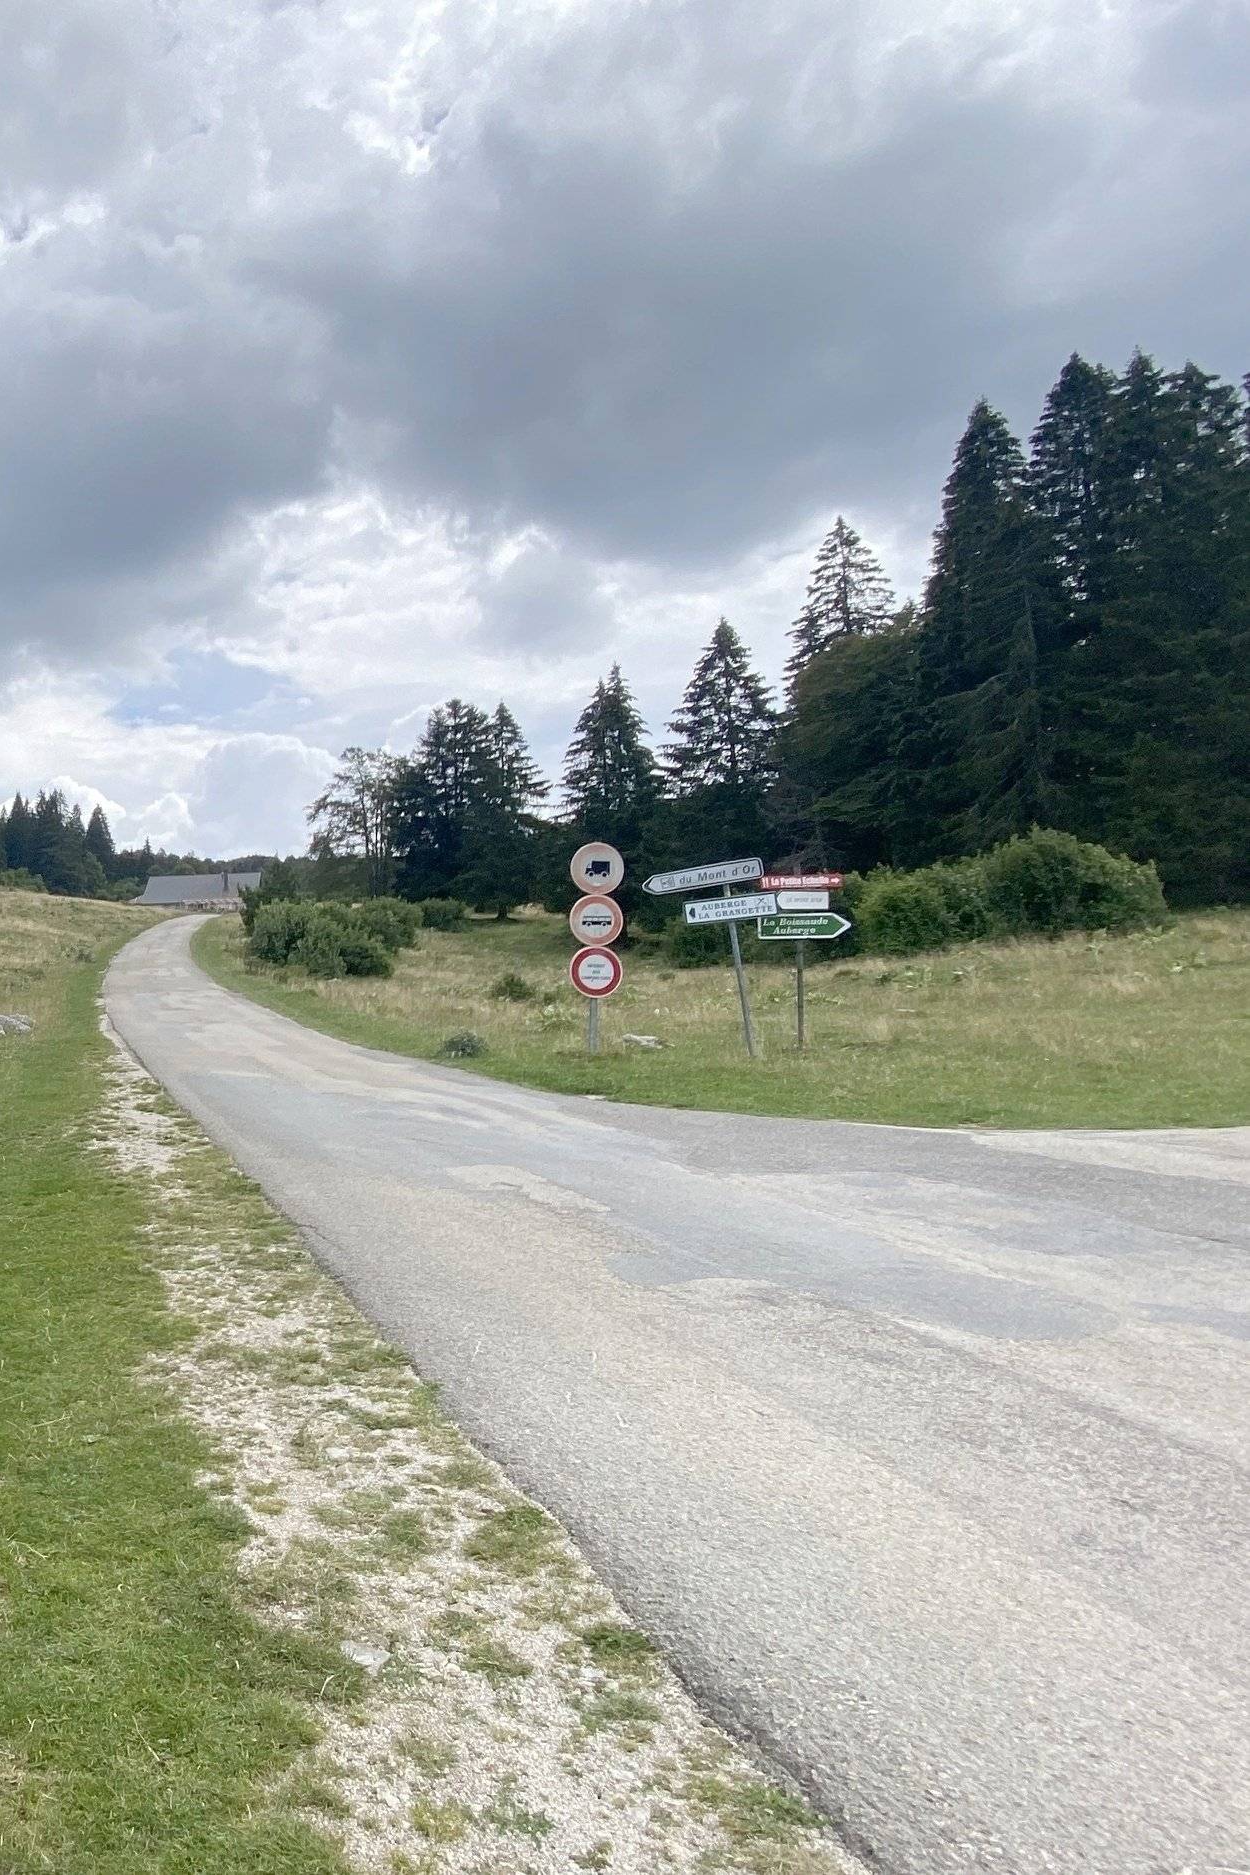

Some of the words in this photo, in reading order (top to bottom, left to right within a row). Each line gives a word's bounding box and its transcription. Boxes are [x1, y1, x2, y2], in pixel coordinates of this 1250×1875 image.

[679, 876, 692, 884] du
[698, 869, 727, 881] Mont
[701, 900, 747, 911] AUBERGE
[763, 918, 776, 926] La
[773, 926, 817, 935] Auberge
